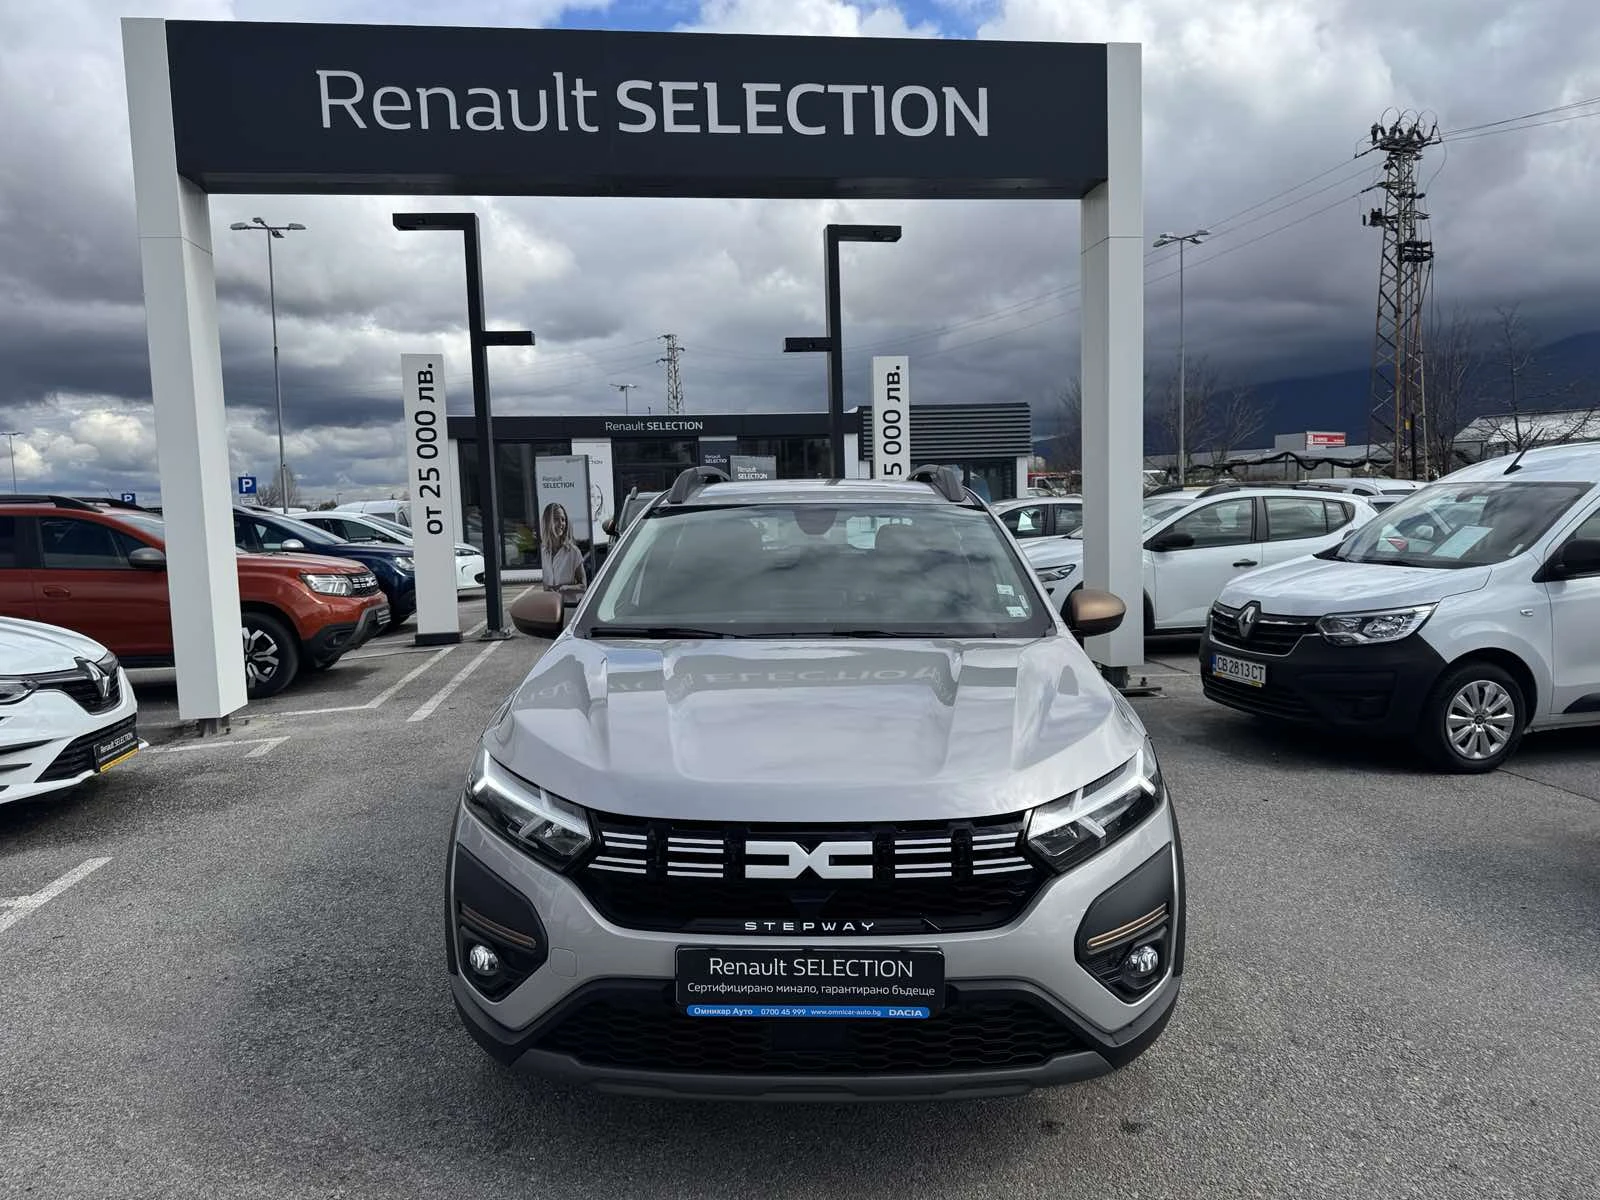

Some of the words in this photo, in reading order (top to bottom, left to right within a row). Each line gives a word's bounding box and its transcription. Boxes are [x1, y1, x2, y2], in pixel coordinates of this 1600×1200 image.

[315, 69, 600, 133] Renault
[616, 79, 989, 137] SELECTION
[605, 420, 645, 431] Renault
[646, 420, 704, 431] SELECTION
[882, 409, 902, 456] 000
[414, 410, 439, 460] 000
[418, 467, 441, 499] 25
[738, 472, 768, 480] SELECTION
[242, 478, 253, 493] P
[744, 921, 874, 931] STEPWAY
[709, 957, 788, 976] Renault
[793, 958, 913, 978] SELECTION
[687, 982, 774, 995] Сертифицирано
[775, 985, 820, 995] минало,
[821, 985, 890, 996] гарантирано
[891, 984, 936, 997] бъдеще
[693, 1007, 731, 1017] Омникар
[732, 1007, 754, 1016] Ауто
[760, 1008, 780, 1016] 0700
[780, 1008, 791, 1016] 45
[792, 1008, 808, 1016] 999
[811, 1008, 882, 1018] www.omnicar-auto.bg
[888, 1009, 923, 1017] DACIA
